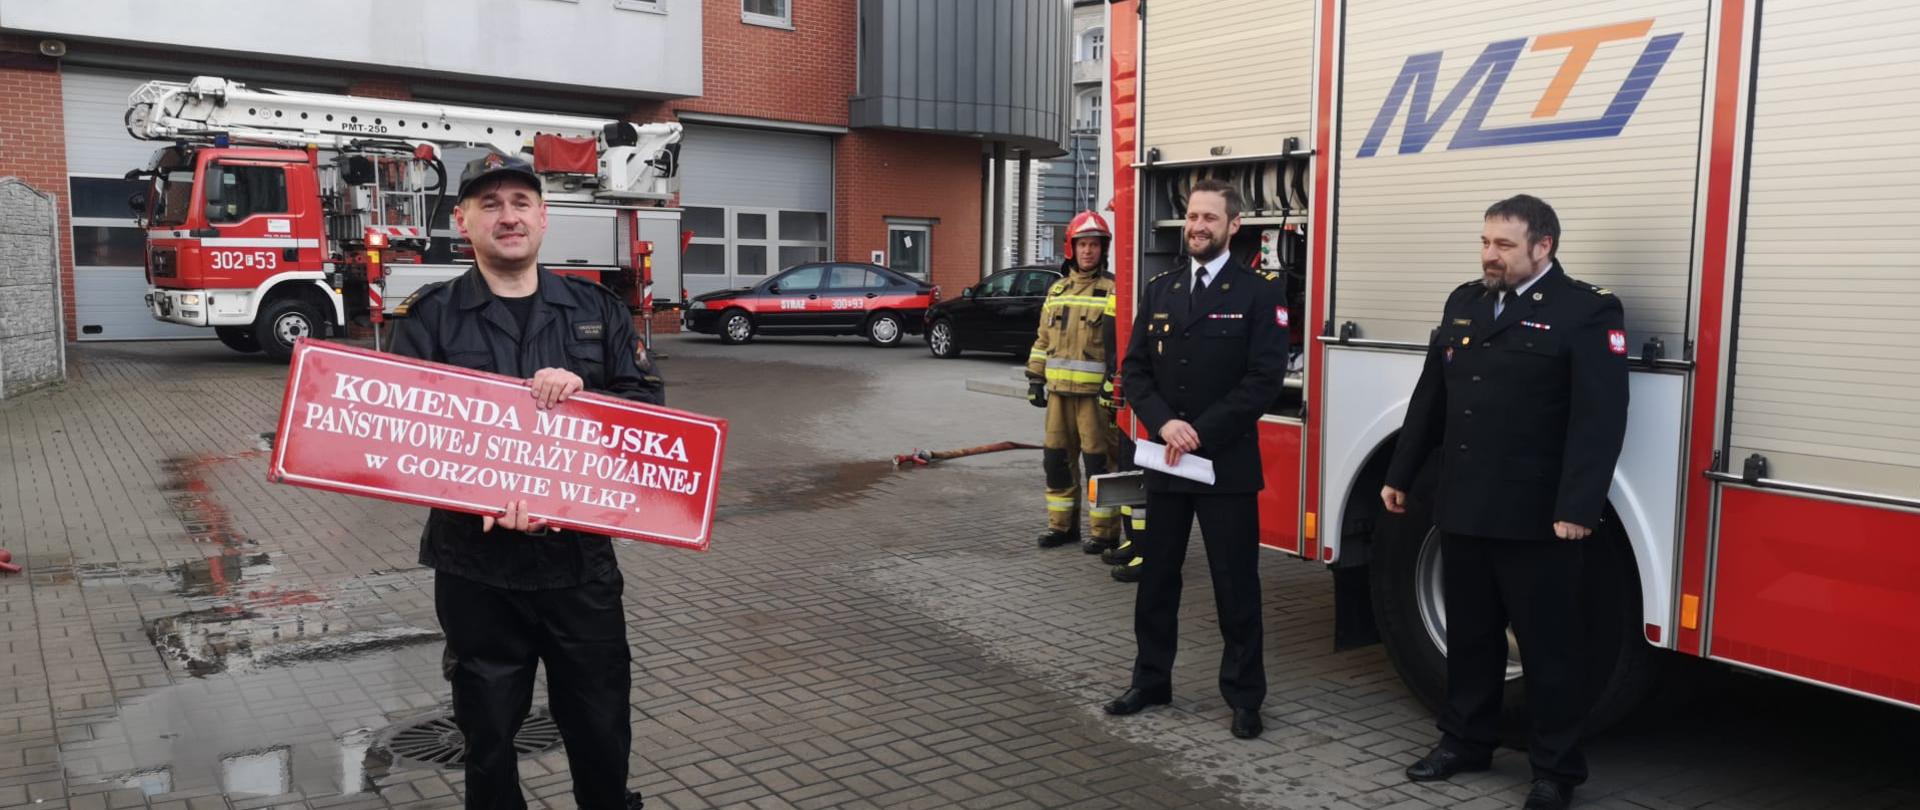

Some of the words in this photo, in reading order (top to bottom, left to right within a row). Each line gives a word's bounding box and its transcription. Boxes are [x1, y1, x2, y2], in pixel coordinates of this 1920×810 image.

[341, 122, 388, 133] PMT-25D
[303, 402, 479, 456] PAŃSTWOWEJ
[485, 436, 577, 472] STRAŻY
[582, 452, 702, 495] POŻARNEJ
[332, 373, 521, 430] KOMENDA
[536, 410, 689, 462] MIEJSKA
[365, 453, 384, 469] w
[397, 454, 550, 497] GORZOWIE
[560, 483, 641, 512] WLKP.
